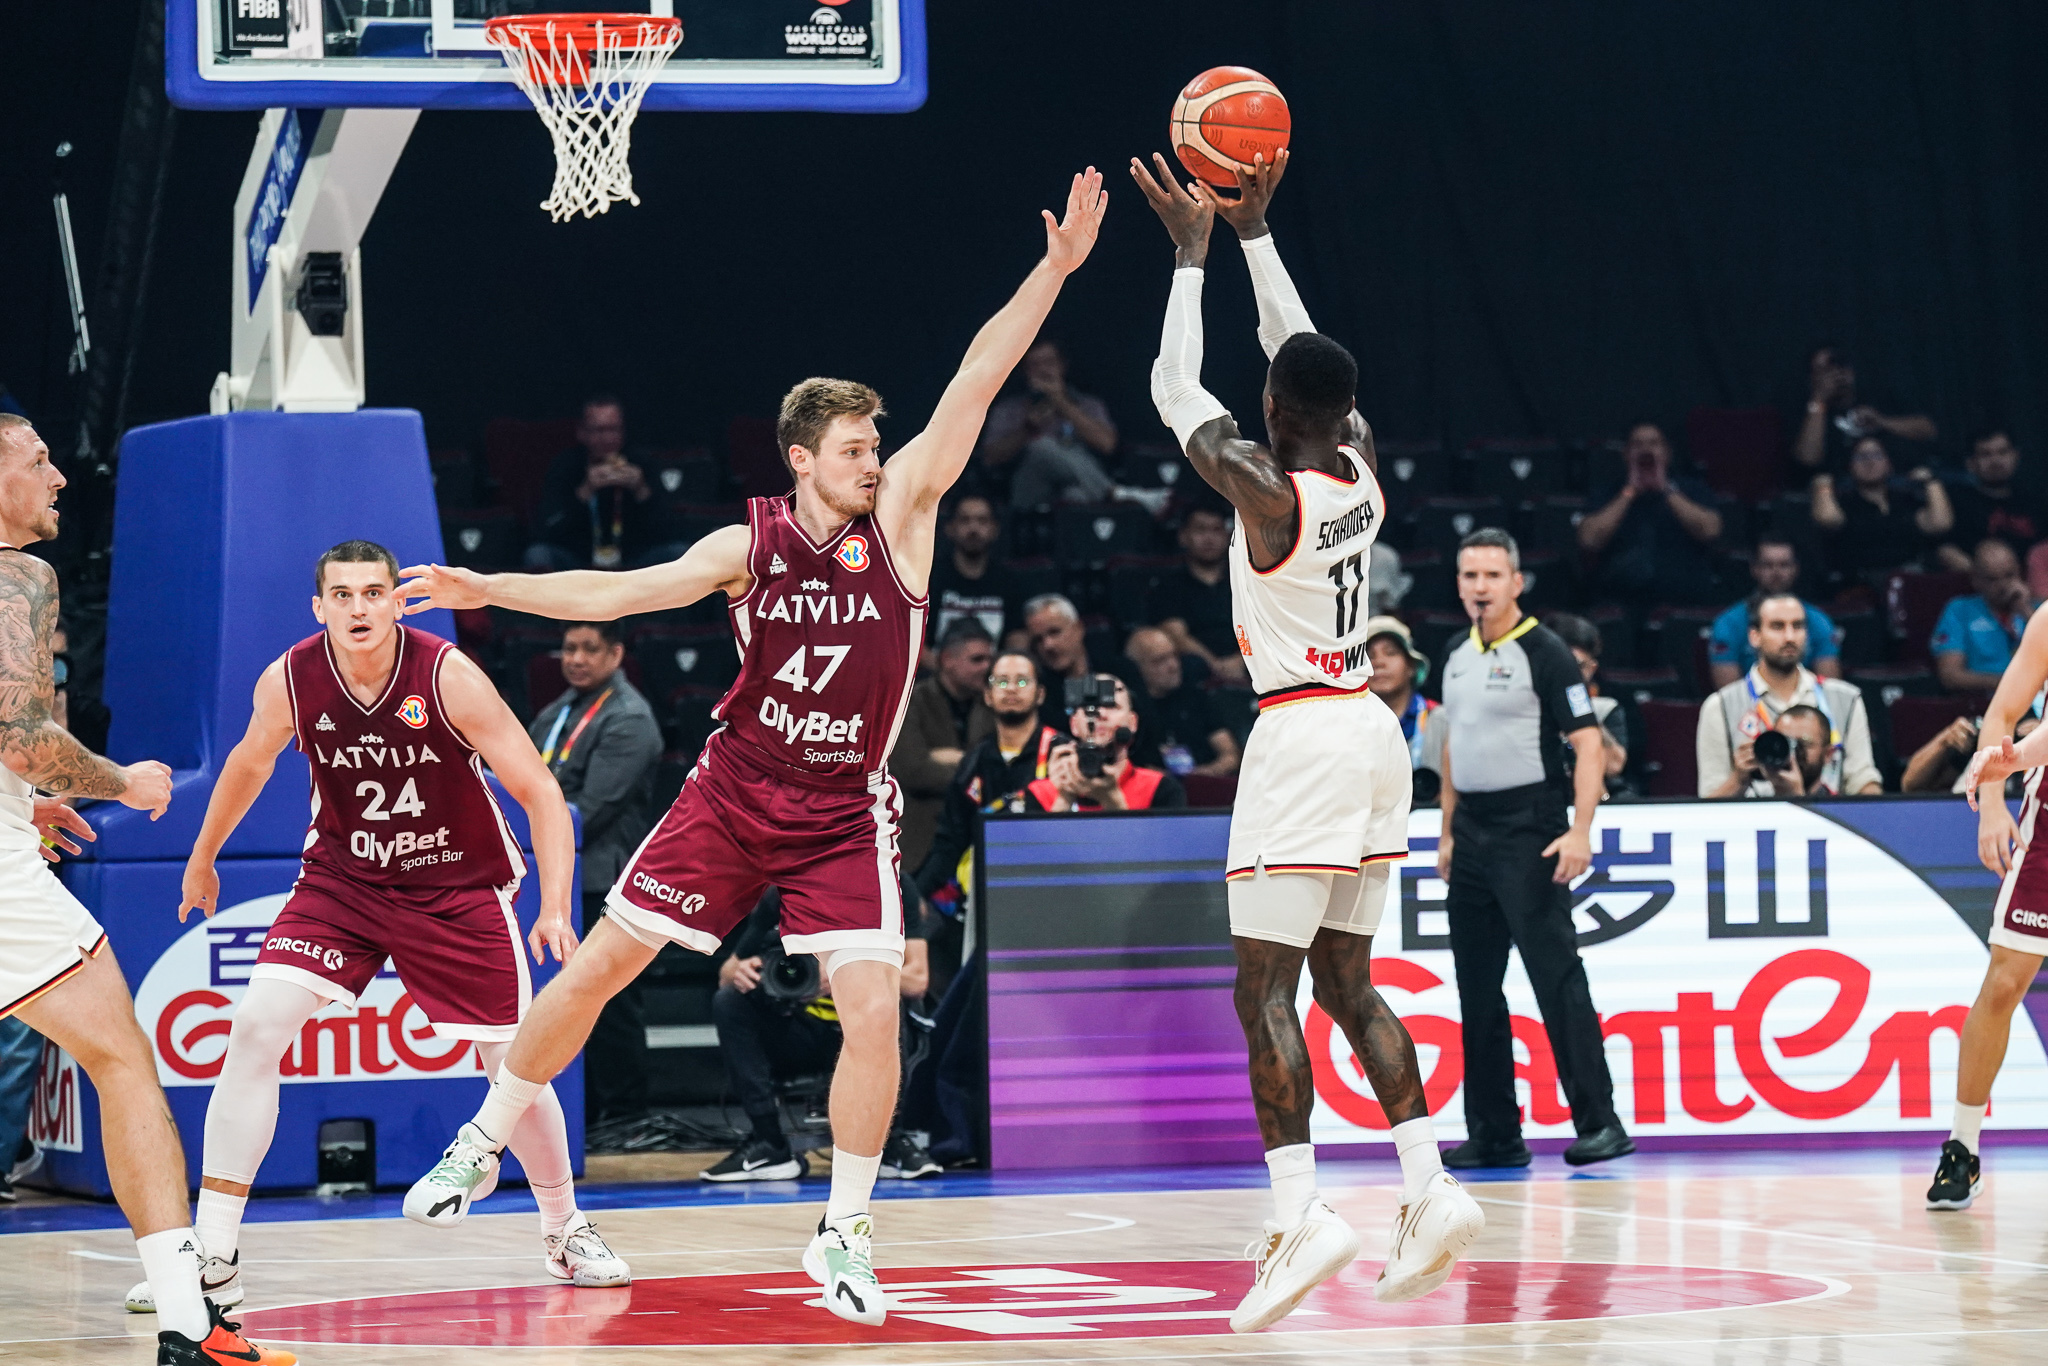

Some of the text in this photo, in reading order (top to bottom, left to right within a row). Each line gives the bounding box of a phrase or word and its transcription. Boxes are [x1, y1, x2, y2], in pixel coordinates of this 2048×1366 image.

[238, 0, 280, 18] FIBA
[785, 33, 868, 46] WORLD CUP
[755, 590, 882, 625] LATVIJA
[1328, 551, 1364, 638] 11
[772, 644, 852, 695] 47
[315, 723, 337, 731] PEAK
[759, 696, 864, 745] OlyBet
[315, 743, 441, 769] LATVIJA
[355, 777, 426, 820] 24
[350, 826, 450, 868] OlyBet
[400, 850, 464, 872] Sports Bar
[633, 871, 705, 914] CIRCLE K
[2011, 908, 2048, 929] CIRC
[266, 937, 343, 970] CIRCLE K
[156, 990, 484, 1079] Gnte
